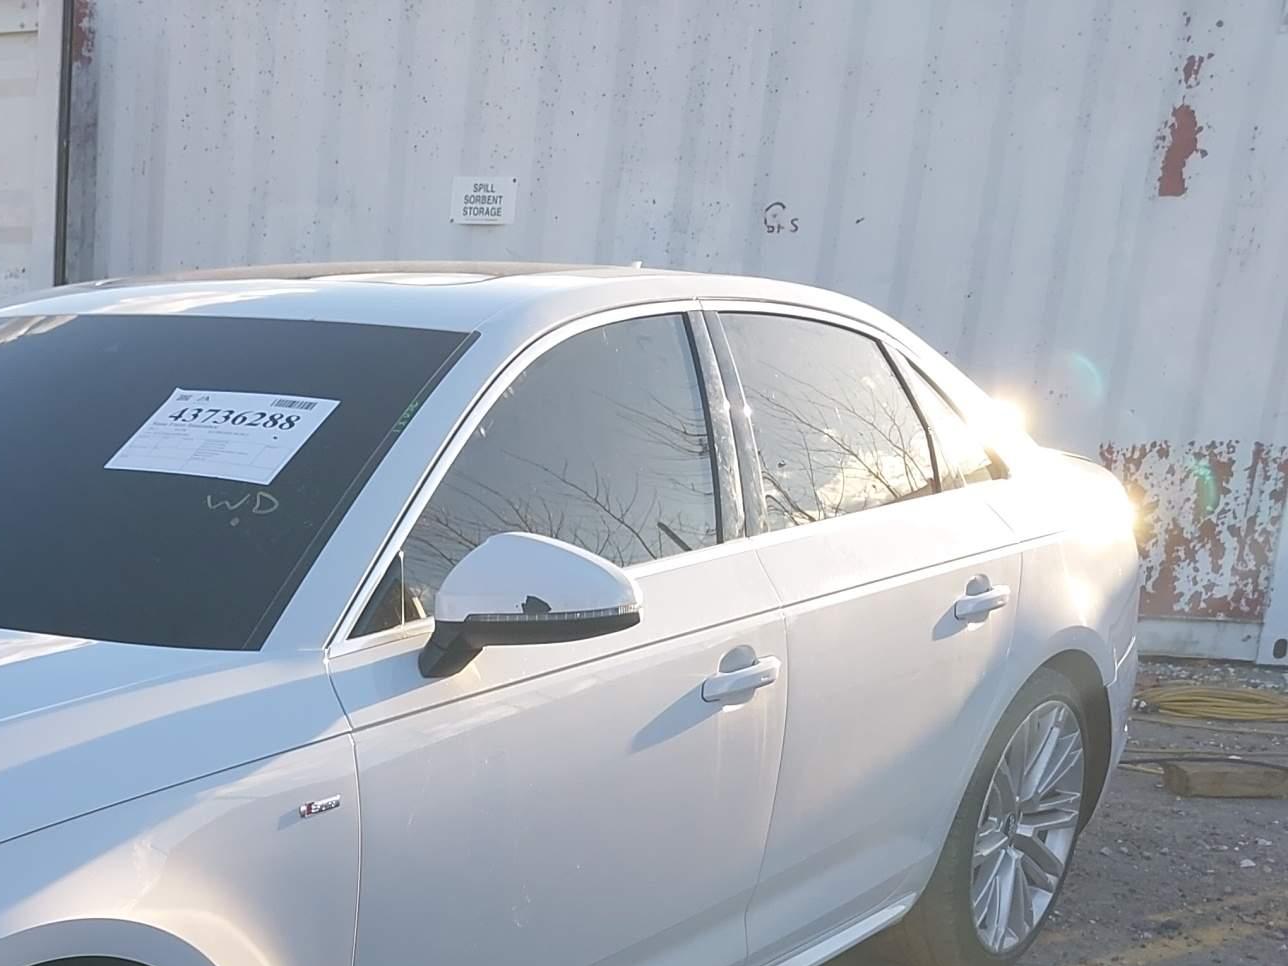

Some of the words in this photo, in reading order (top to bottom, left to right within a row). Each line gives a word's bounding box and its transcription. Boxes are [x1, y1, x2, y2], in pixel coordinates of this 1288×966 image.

[473, 183, 496, 193] SPILL
[463, 194, 504, 205] SORBENT
[462, 206, 503, 217] STORAGE
[168, 407, 302, 431] 43736288
